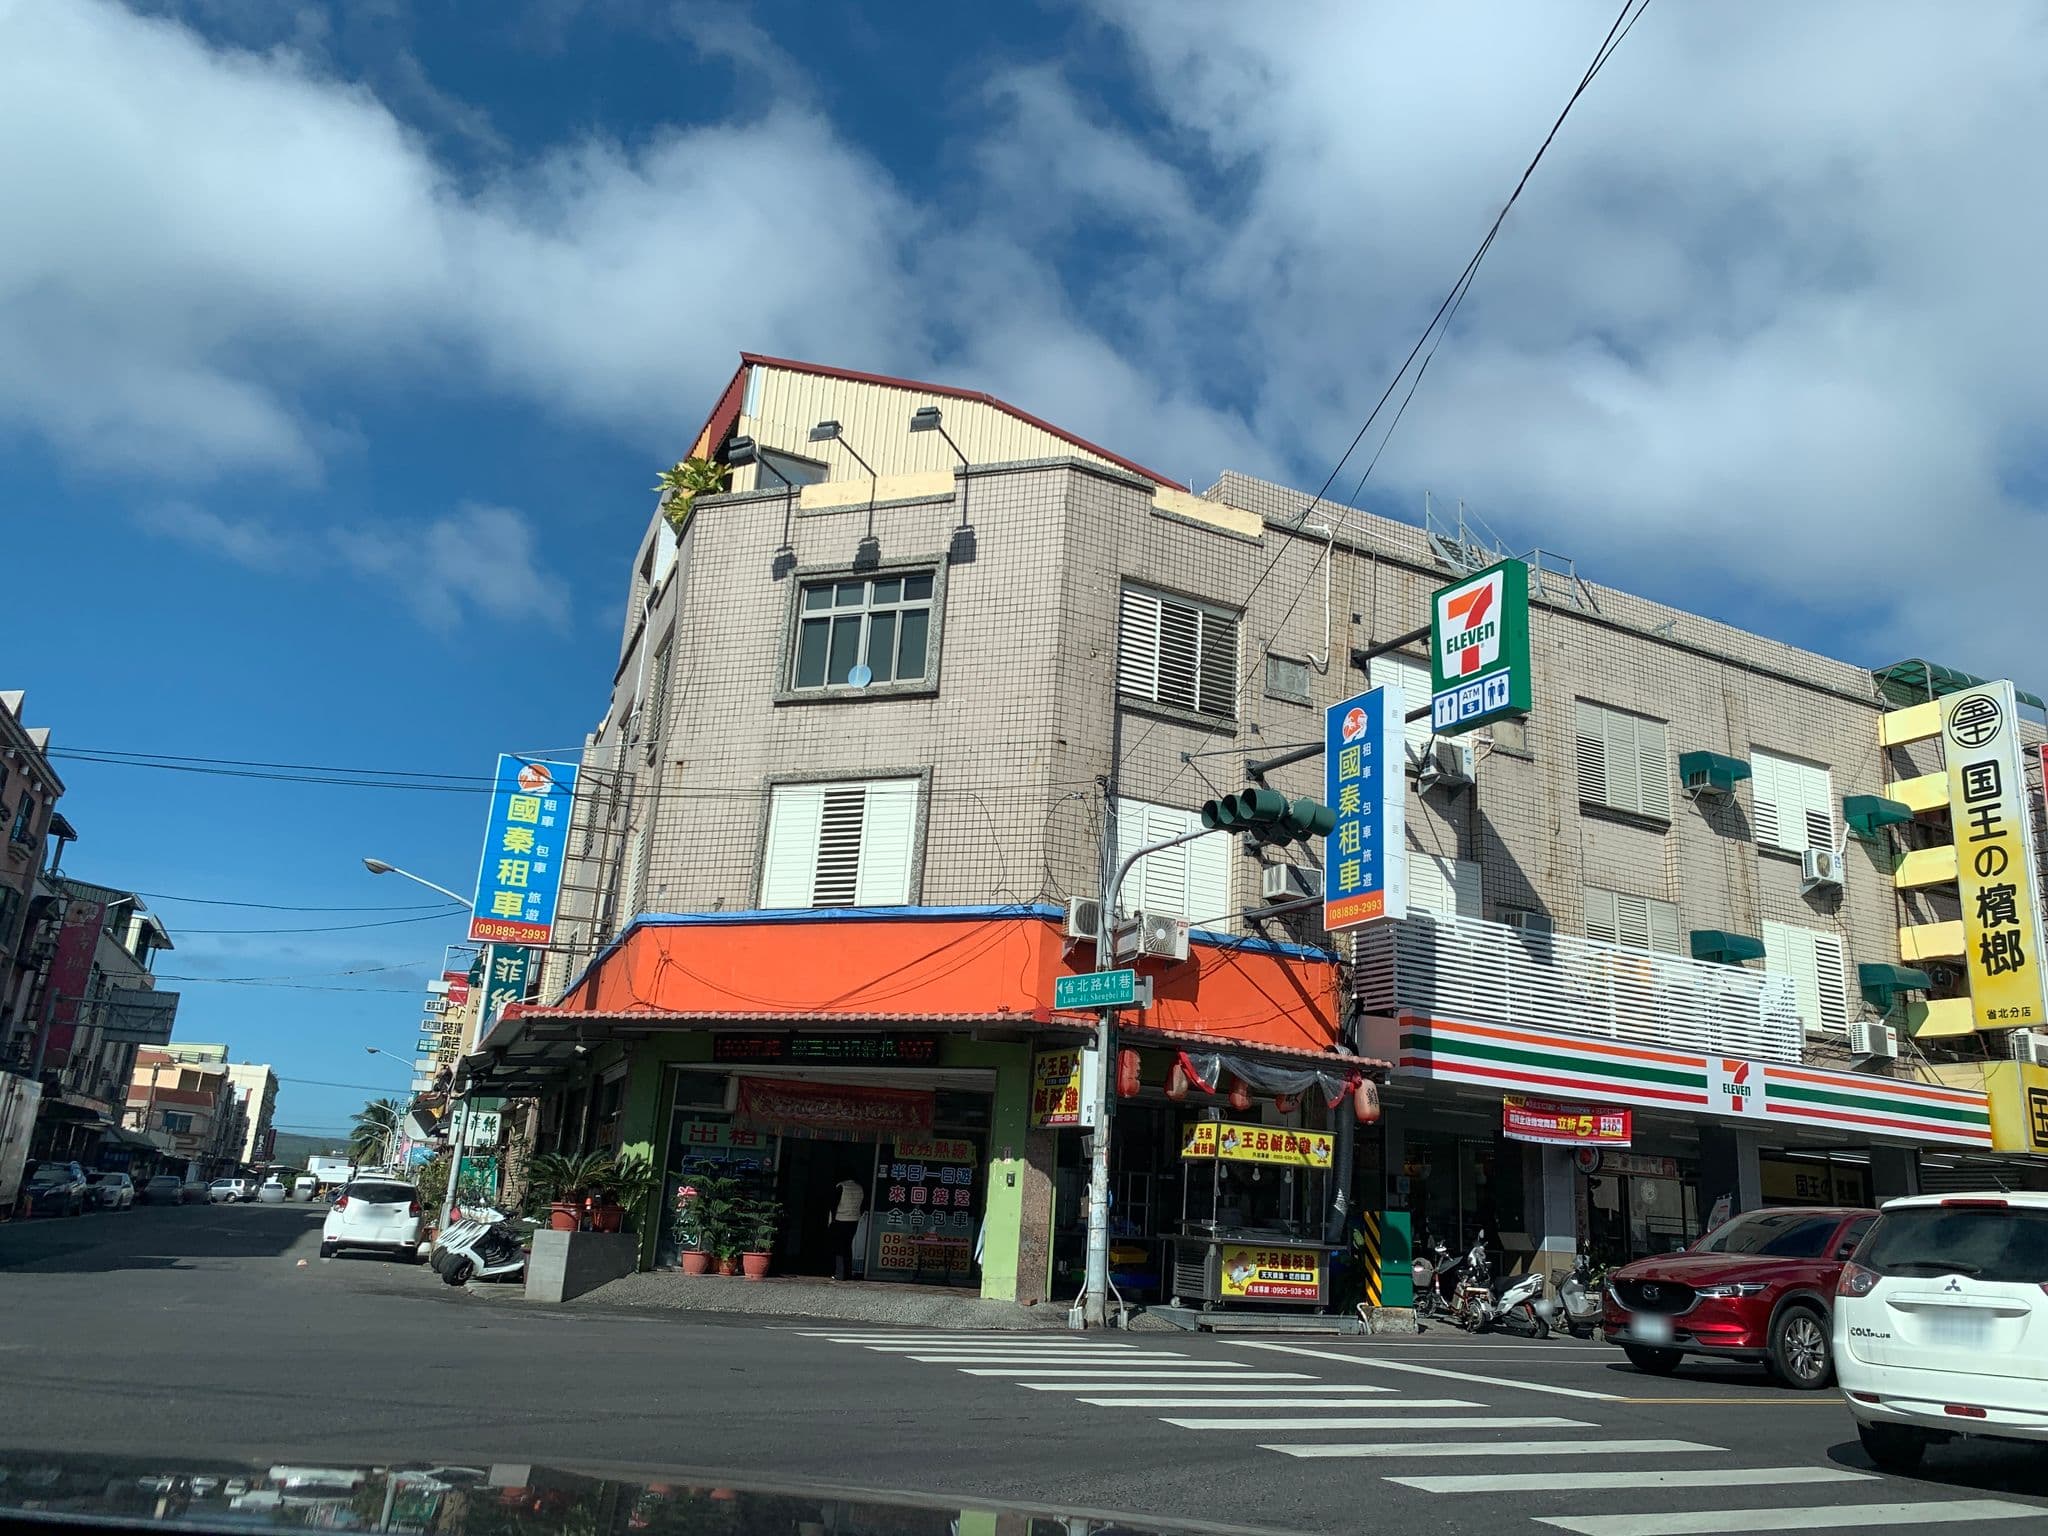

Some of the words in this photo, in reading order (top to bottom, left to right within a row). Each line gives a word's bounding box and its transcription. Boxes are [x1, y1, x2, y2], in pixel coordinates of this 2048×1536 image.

[1462, 687, 1480, 701] ATM
[1362, 742, 1372, 779] 租車
[541, 799, 557, 828] 租車
[1362, 802, 1372, 840] 包車
[533, 845, 550, 874] 包車
[1362, 848, 1372, 887] 旅遊
[1961, 759, 2025, 976] 国王の檳榔
[525, 892, 542, 922] 旅遊
[1329, 898, 1382, 920] (08)889-2993
[474, 921, 547, 941] (08)889-2993
[1064, 973, 1131, 994] 省北路41巷
[1063, 996, 1078, 1004] Lane
[1090, 990, 1118, 1001] Shengbei
[1986, 1007, 2031, 1021] 省北分店
[1047, 1055, 1069, 1076] 王品
[1198, 1127, 1213, 1140] 王品
[888, 1185, 970, 1207] 來回接送
[887, 1207, 969, 1227] 全台包車
[1850, 1327, 1871, 1337] COLT
